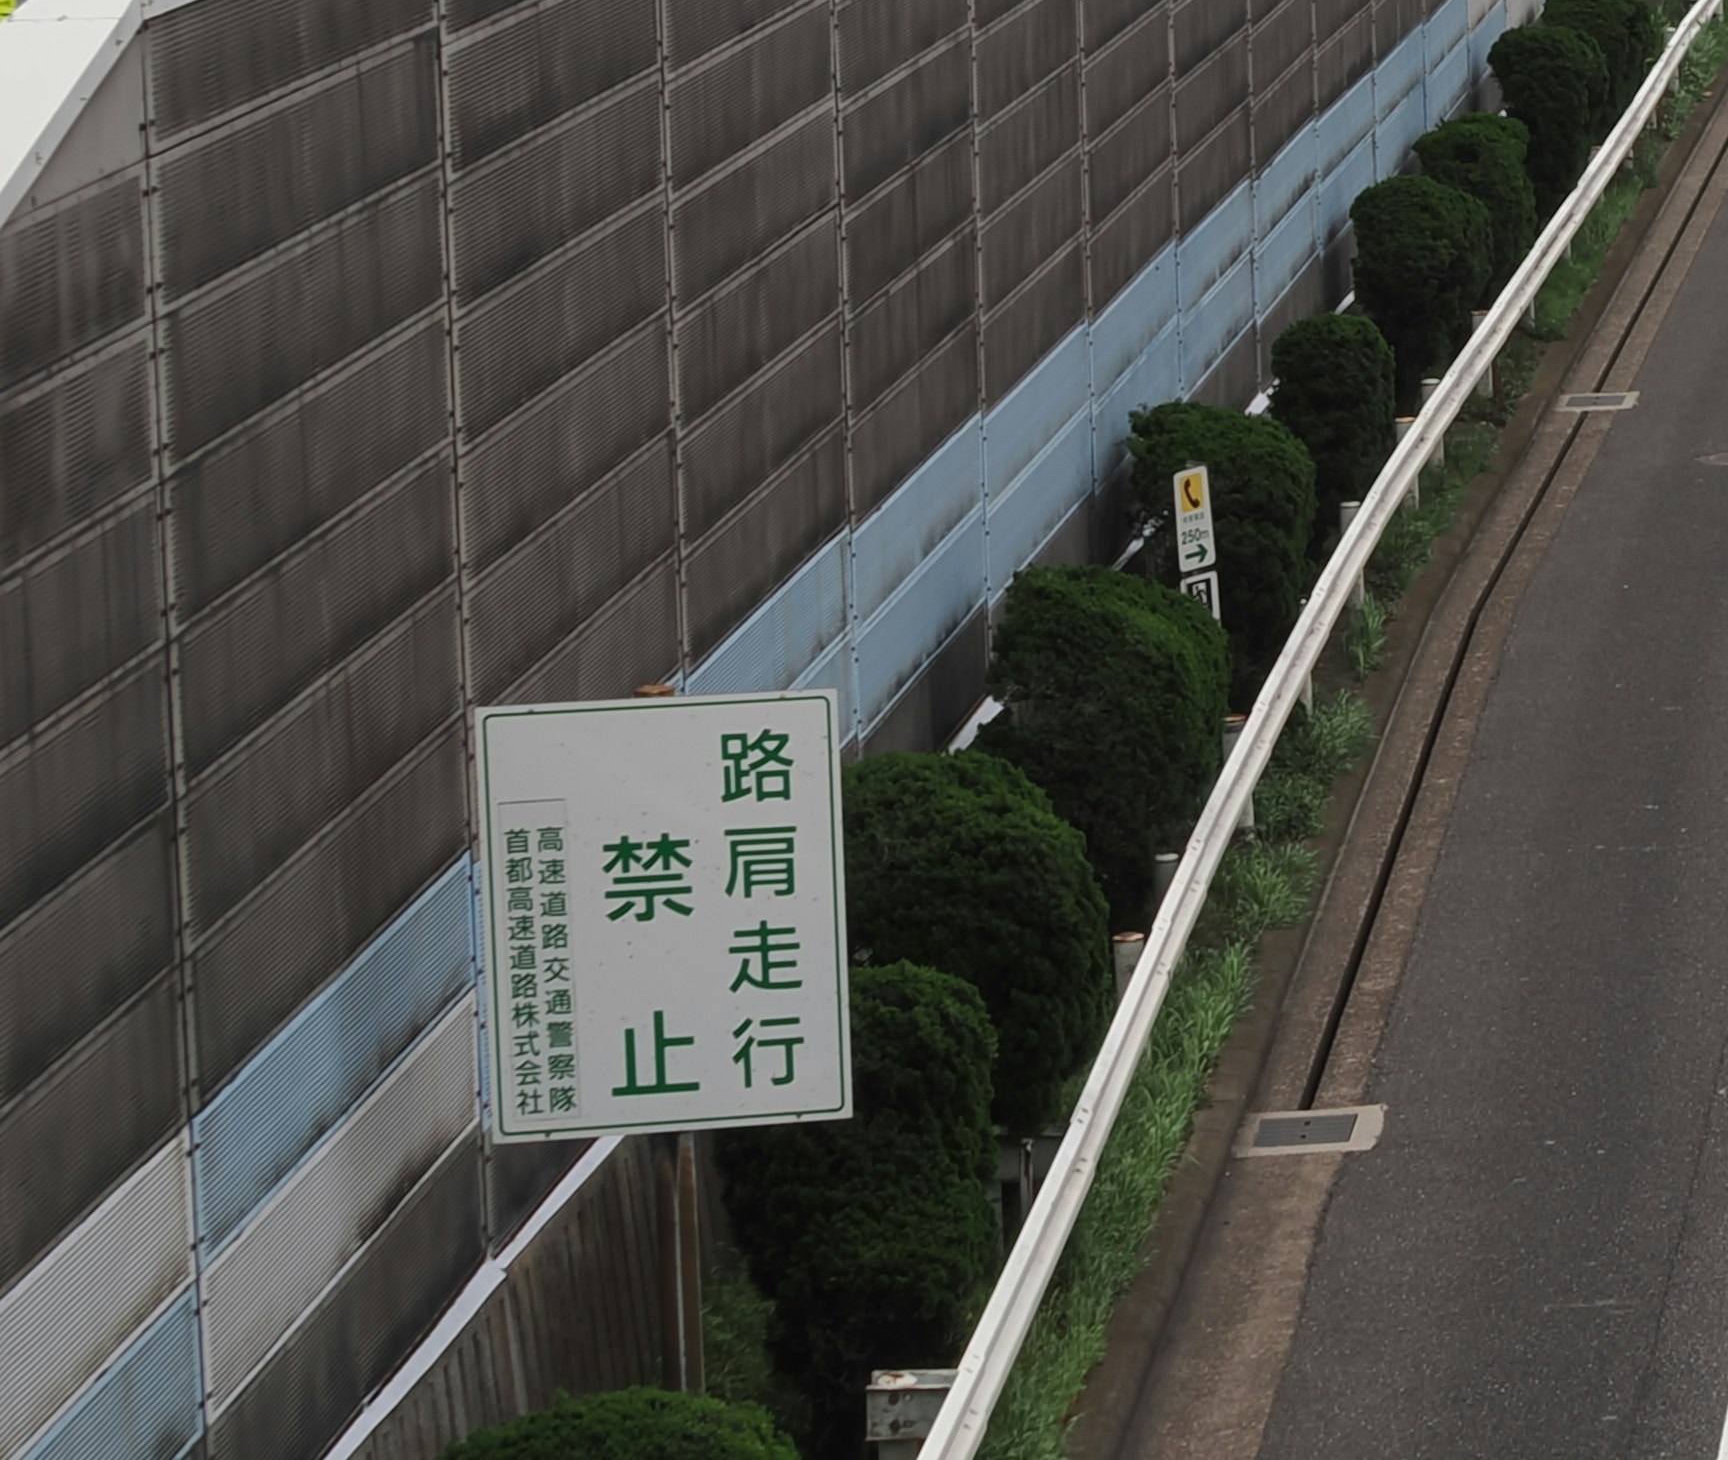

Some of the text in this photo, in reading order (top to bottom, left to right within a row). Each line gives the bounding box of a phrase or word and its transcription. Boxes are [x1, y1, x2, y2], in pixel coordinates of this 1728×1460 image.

[1181, 527, 1209, 545] 250m
[504, 827, 545, 1116] 首都高速道路株式会社
[536, 825, 578, 1114] 高速道路交通警察隊
[602, 833, 700, 1097] 禁止
[720, 727, 804, 1089] 路肩走行
